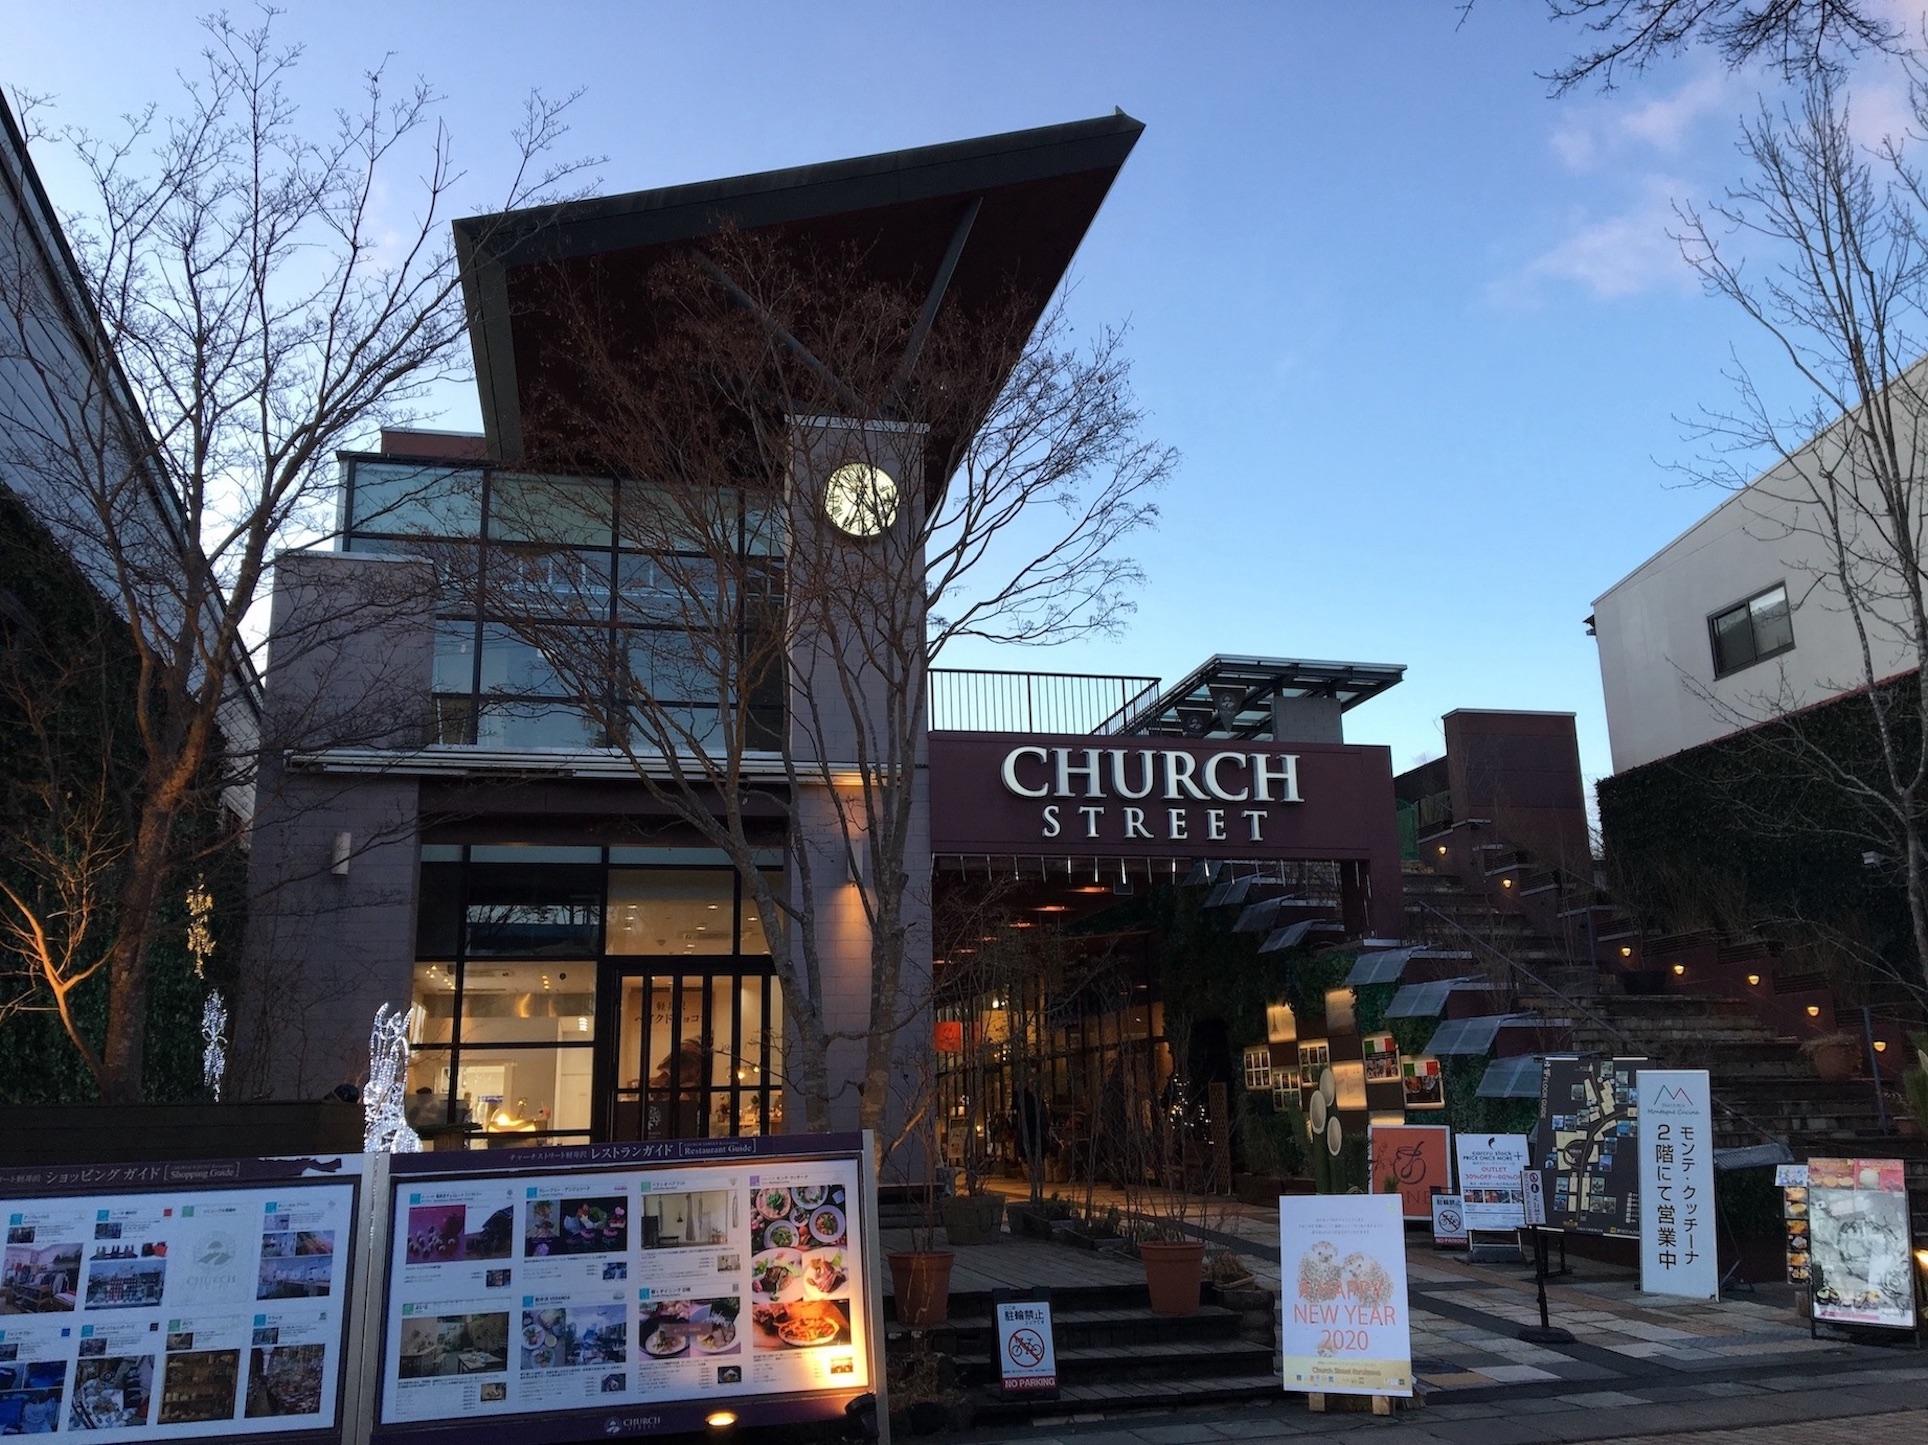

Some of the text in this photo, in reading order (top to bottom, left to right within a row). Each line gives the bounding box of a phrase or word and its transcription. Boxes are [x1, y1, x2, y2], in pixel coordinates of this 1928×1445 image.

[1000, 745, 1304, 802] CHURCH
[1042, 805, 1268, 841] STREET
[591, 1144, 673, 1160] レストランガイド
[684, 1145, 726, 1156] Restaurant
[727, 1143, 753, 1154] Guide
[46, 1168, 119, 1184] ショッピング
[123, 1166, 162, 1180] ガイド
[1655, 1124, 1677, 1271] 2階にて営業中
[1680, 1125, 1700, 1266] モンテ・クッチーナ
[1004, 1309, 1044, 1321] 駐輪禁止
[1294, 1303, 1396, 1326] NEW YEAR
[1321, 1329, 1369, 1351] 2020
[1004, 1377, 1056, 1388] NO PARKING
[623, 1415, 661, 1427] CHURCH
